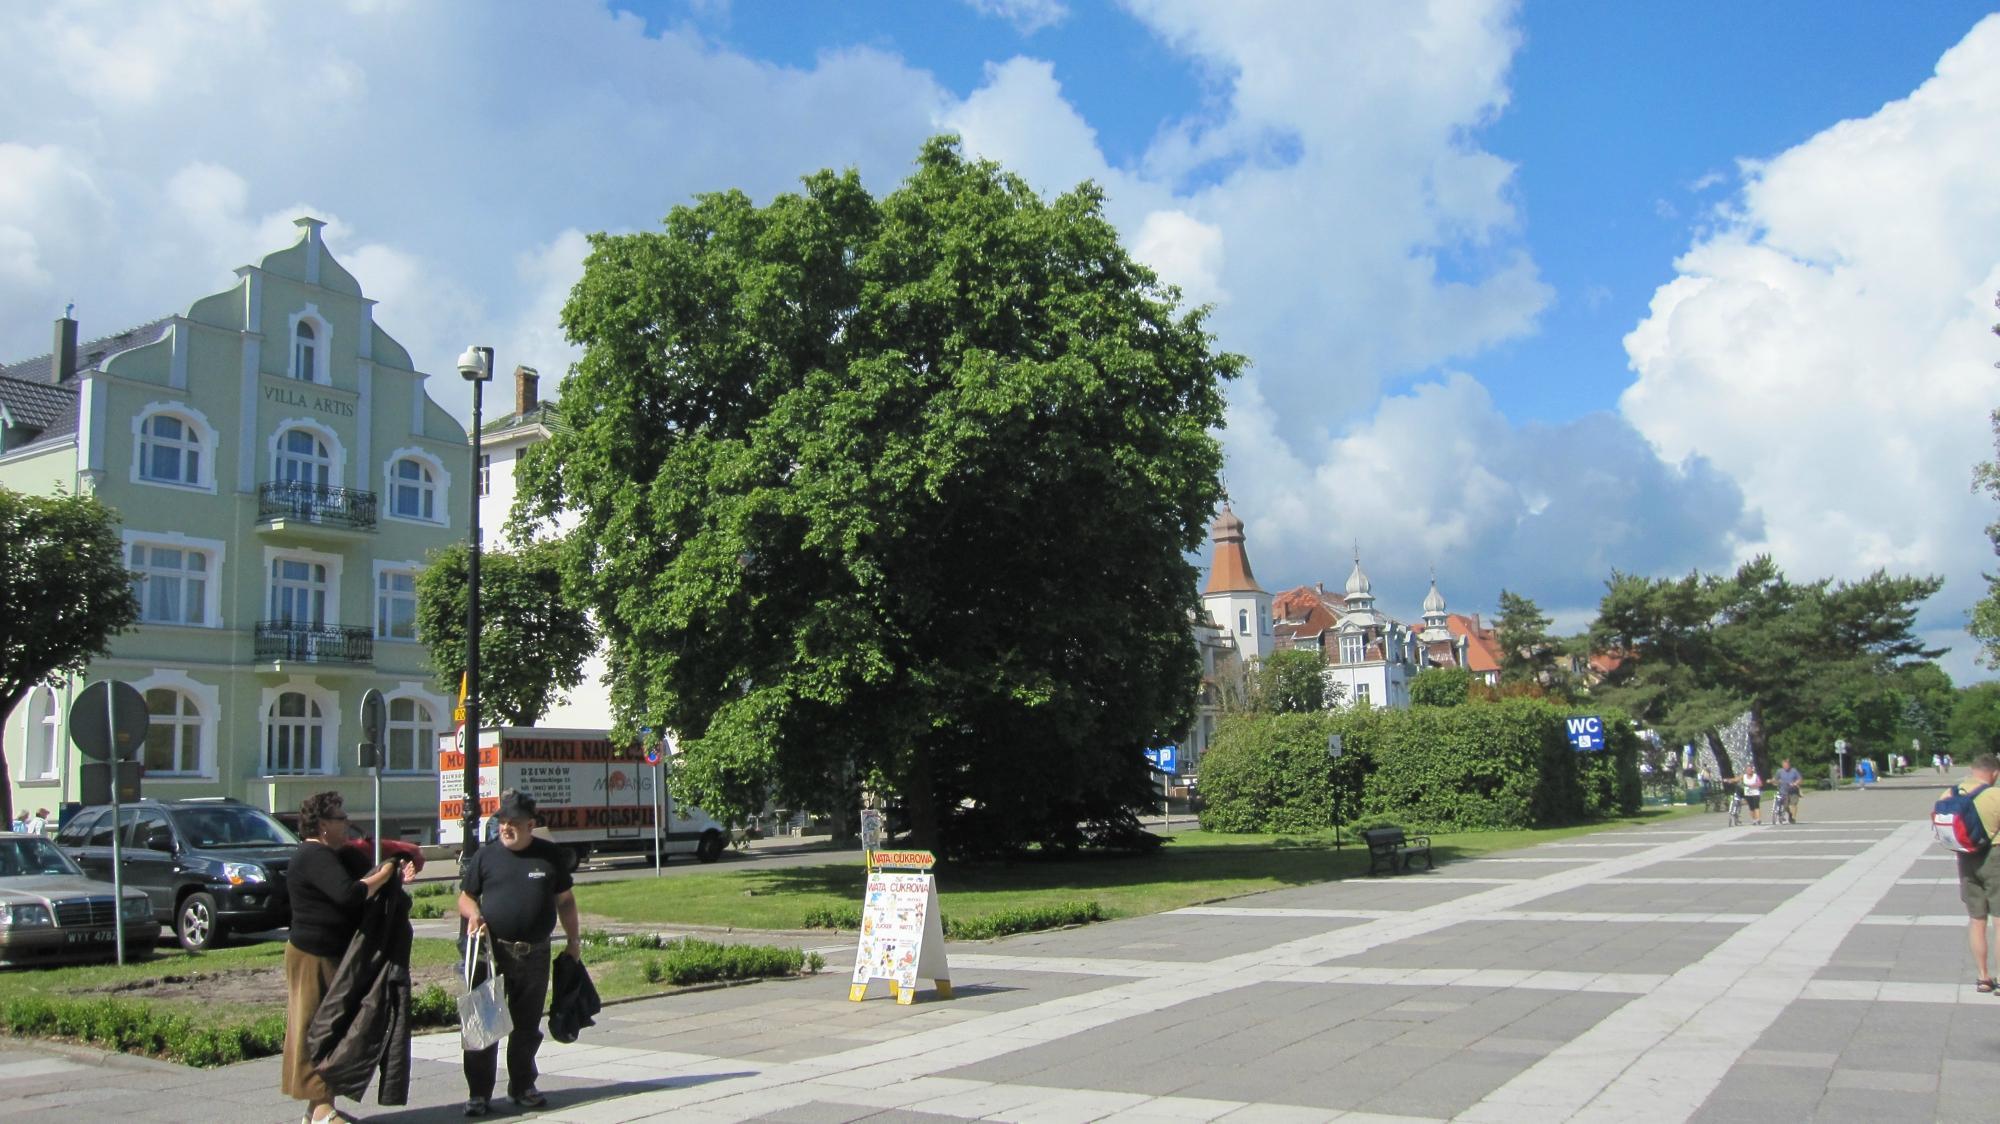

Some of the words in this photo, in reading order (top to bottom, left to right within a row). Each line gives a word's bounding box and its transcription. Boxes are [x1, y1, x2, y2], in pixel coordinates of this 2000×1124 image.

[264, 385, 308, 408] VILLA
[313, 397, 355, 417] ARTIS
[1567, 717, 1599, 734] WC
[1160, 749, 1171, 766] P
[520, 765, 571, 776] DZIWNÓW
[871, 853, 891, 864] WATA
[893, 853, 933, 864] CUKROWA
[868, 882, 887, 893] WATA
[890, 882, 929, 893] CUKROWA
